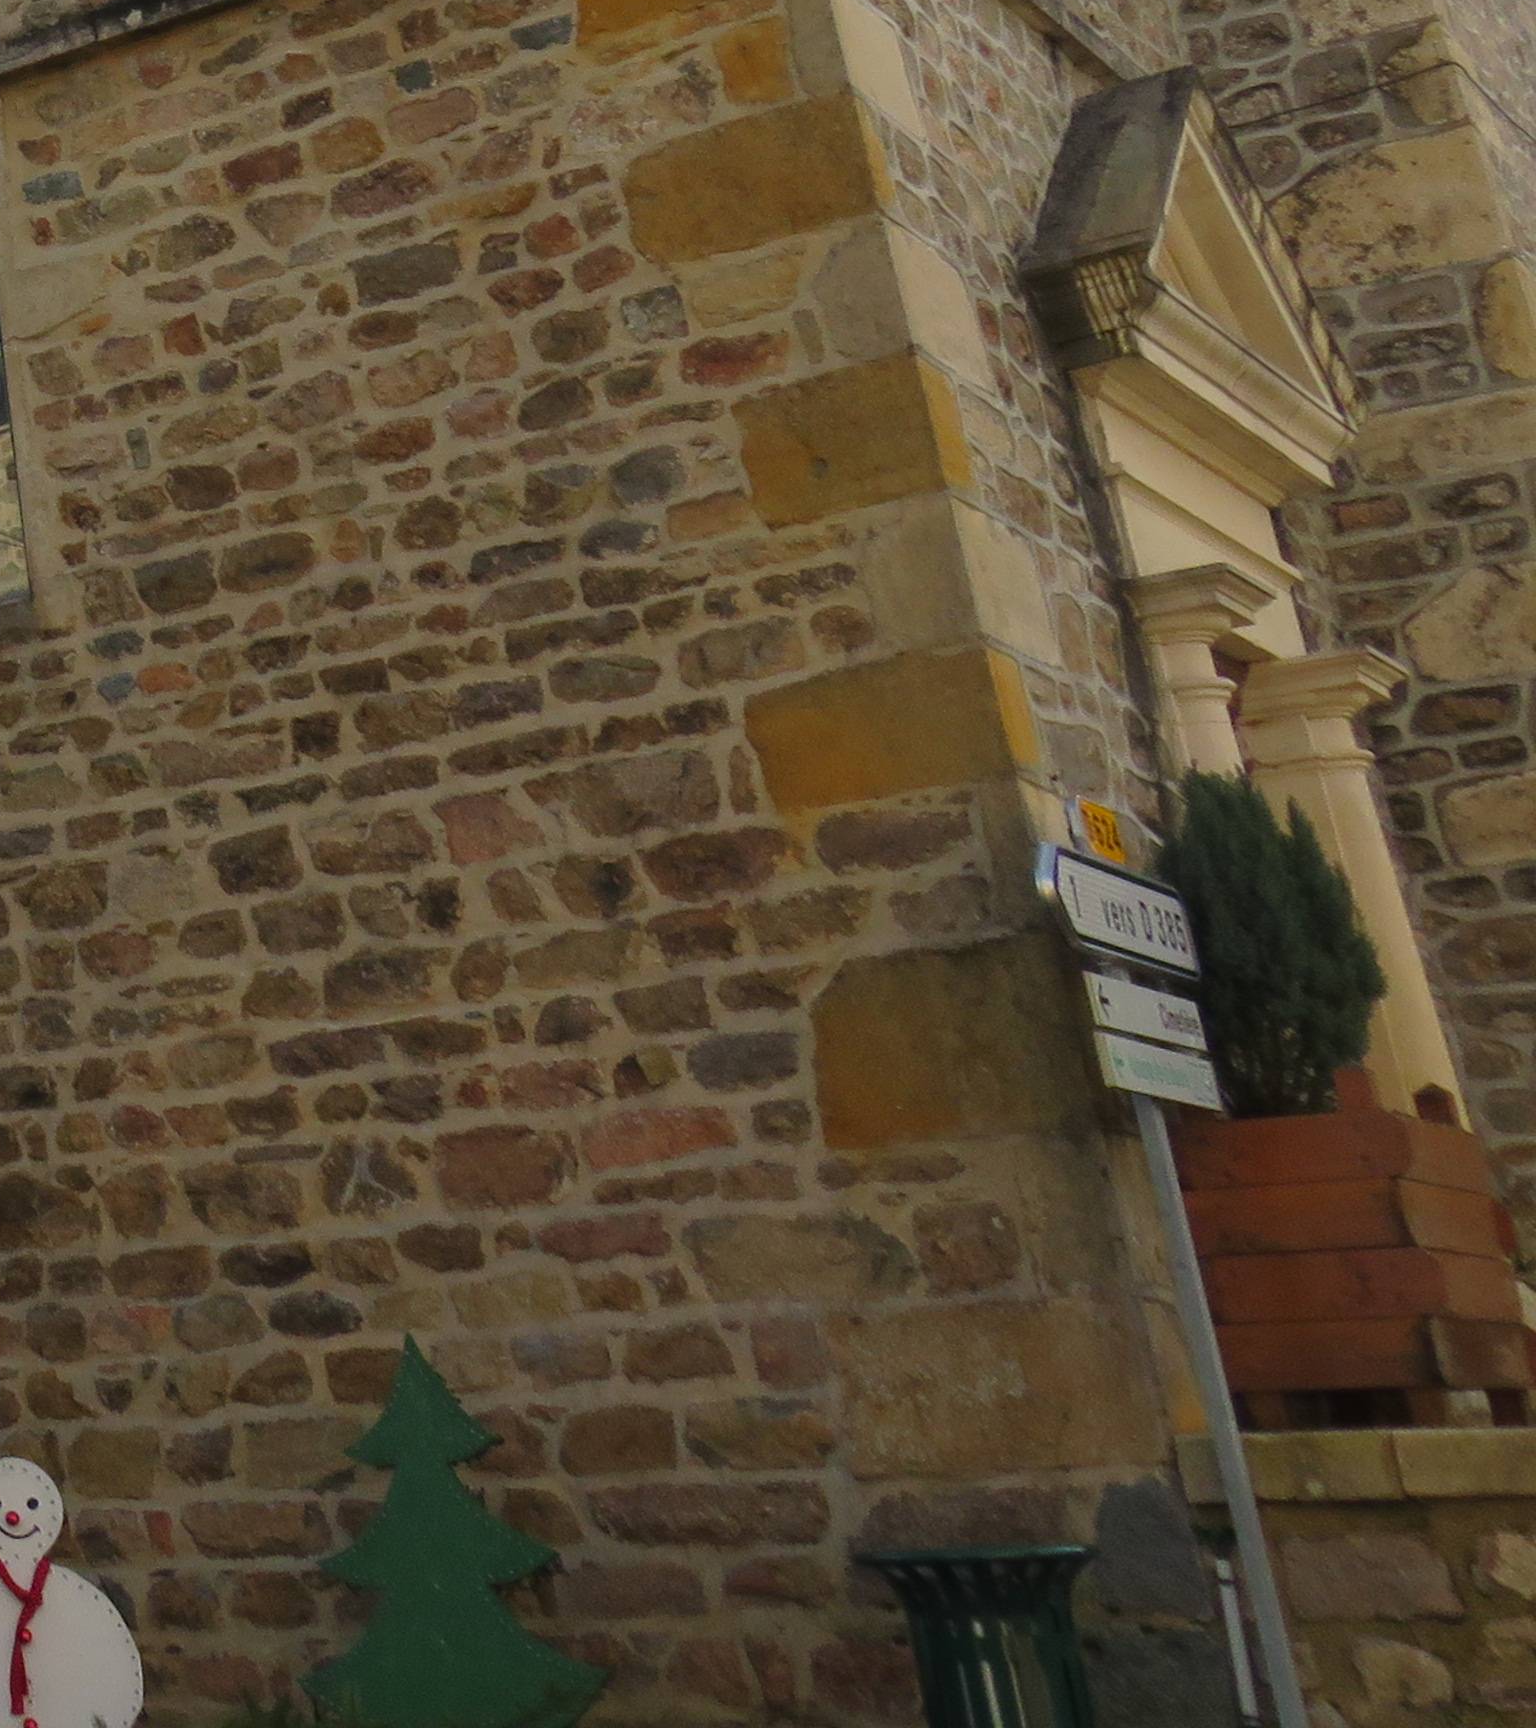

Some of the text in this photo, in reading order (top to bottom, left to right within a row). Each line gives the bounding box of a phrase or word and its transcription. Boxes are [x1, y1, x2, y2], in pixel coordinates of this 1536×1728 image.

[1100, 898, 1189, 954] vers D 385
